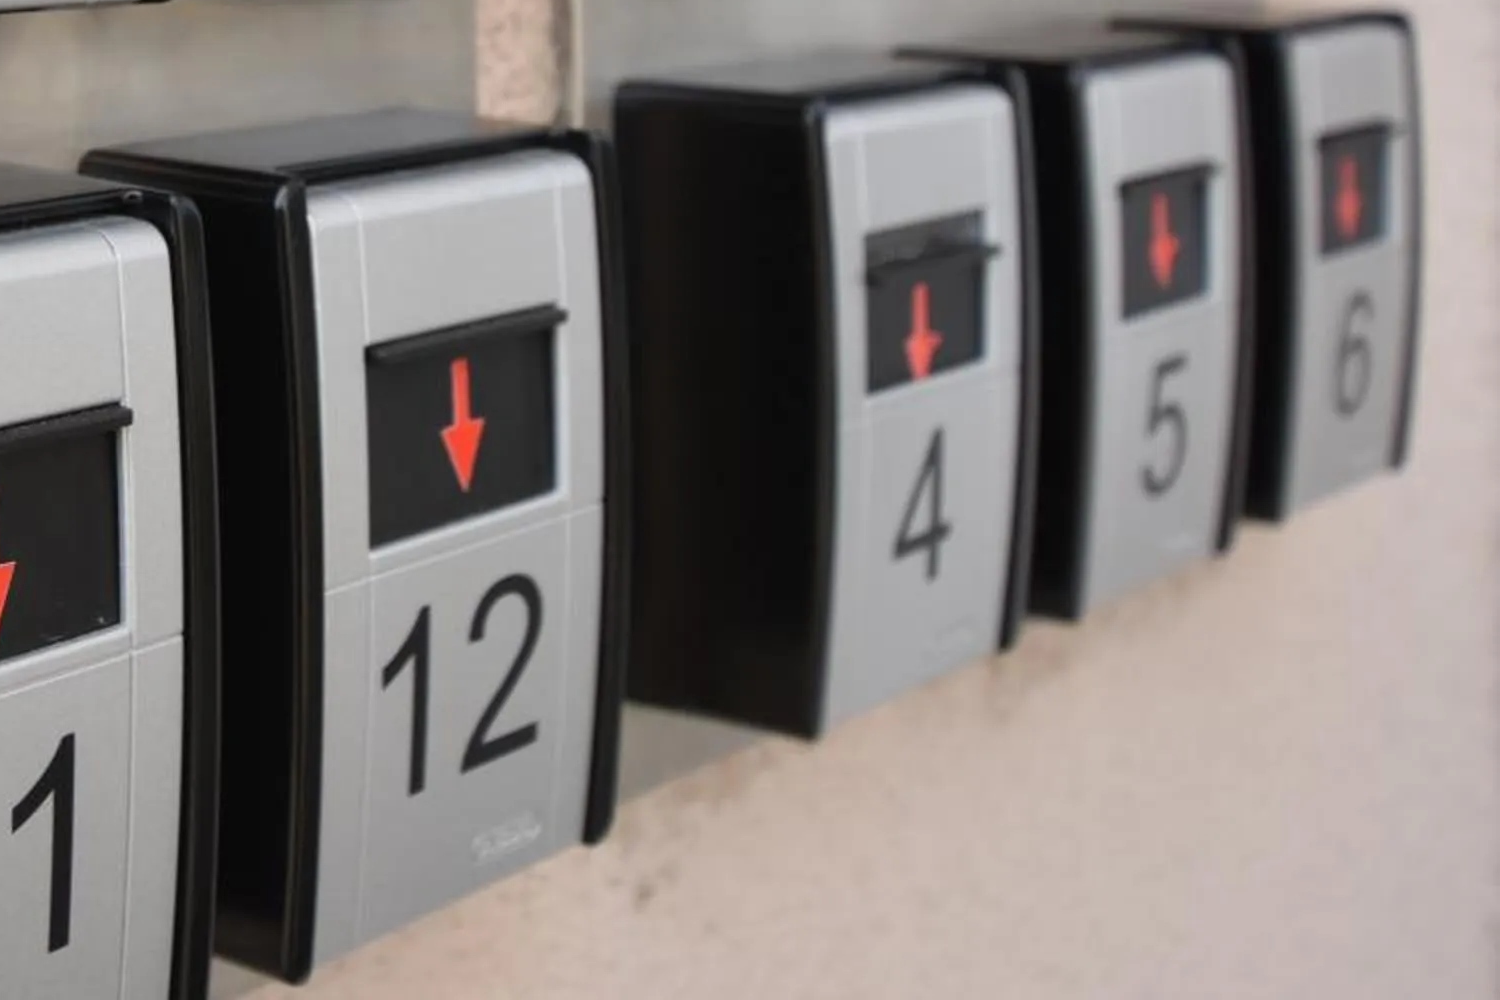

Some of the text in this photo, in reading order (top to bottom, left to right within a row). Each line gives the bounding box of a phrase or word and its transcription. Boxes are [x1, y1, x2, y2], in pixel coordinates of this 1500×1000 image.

[1139, 353, 1190, 500] 5
[1331, 288, 1375, 421] 6
[891, 426, 952, 582] 4
[381, 571, 543, 797] 12
